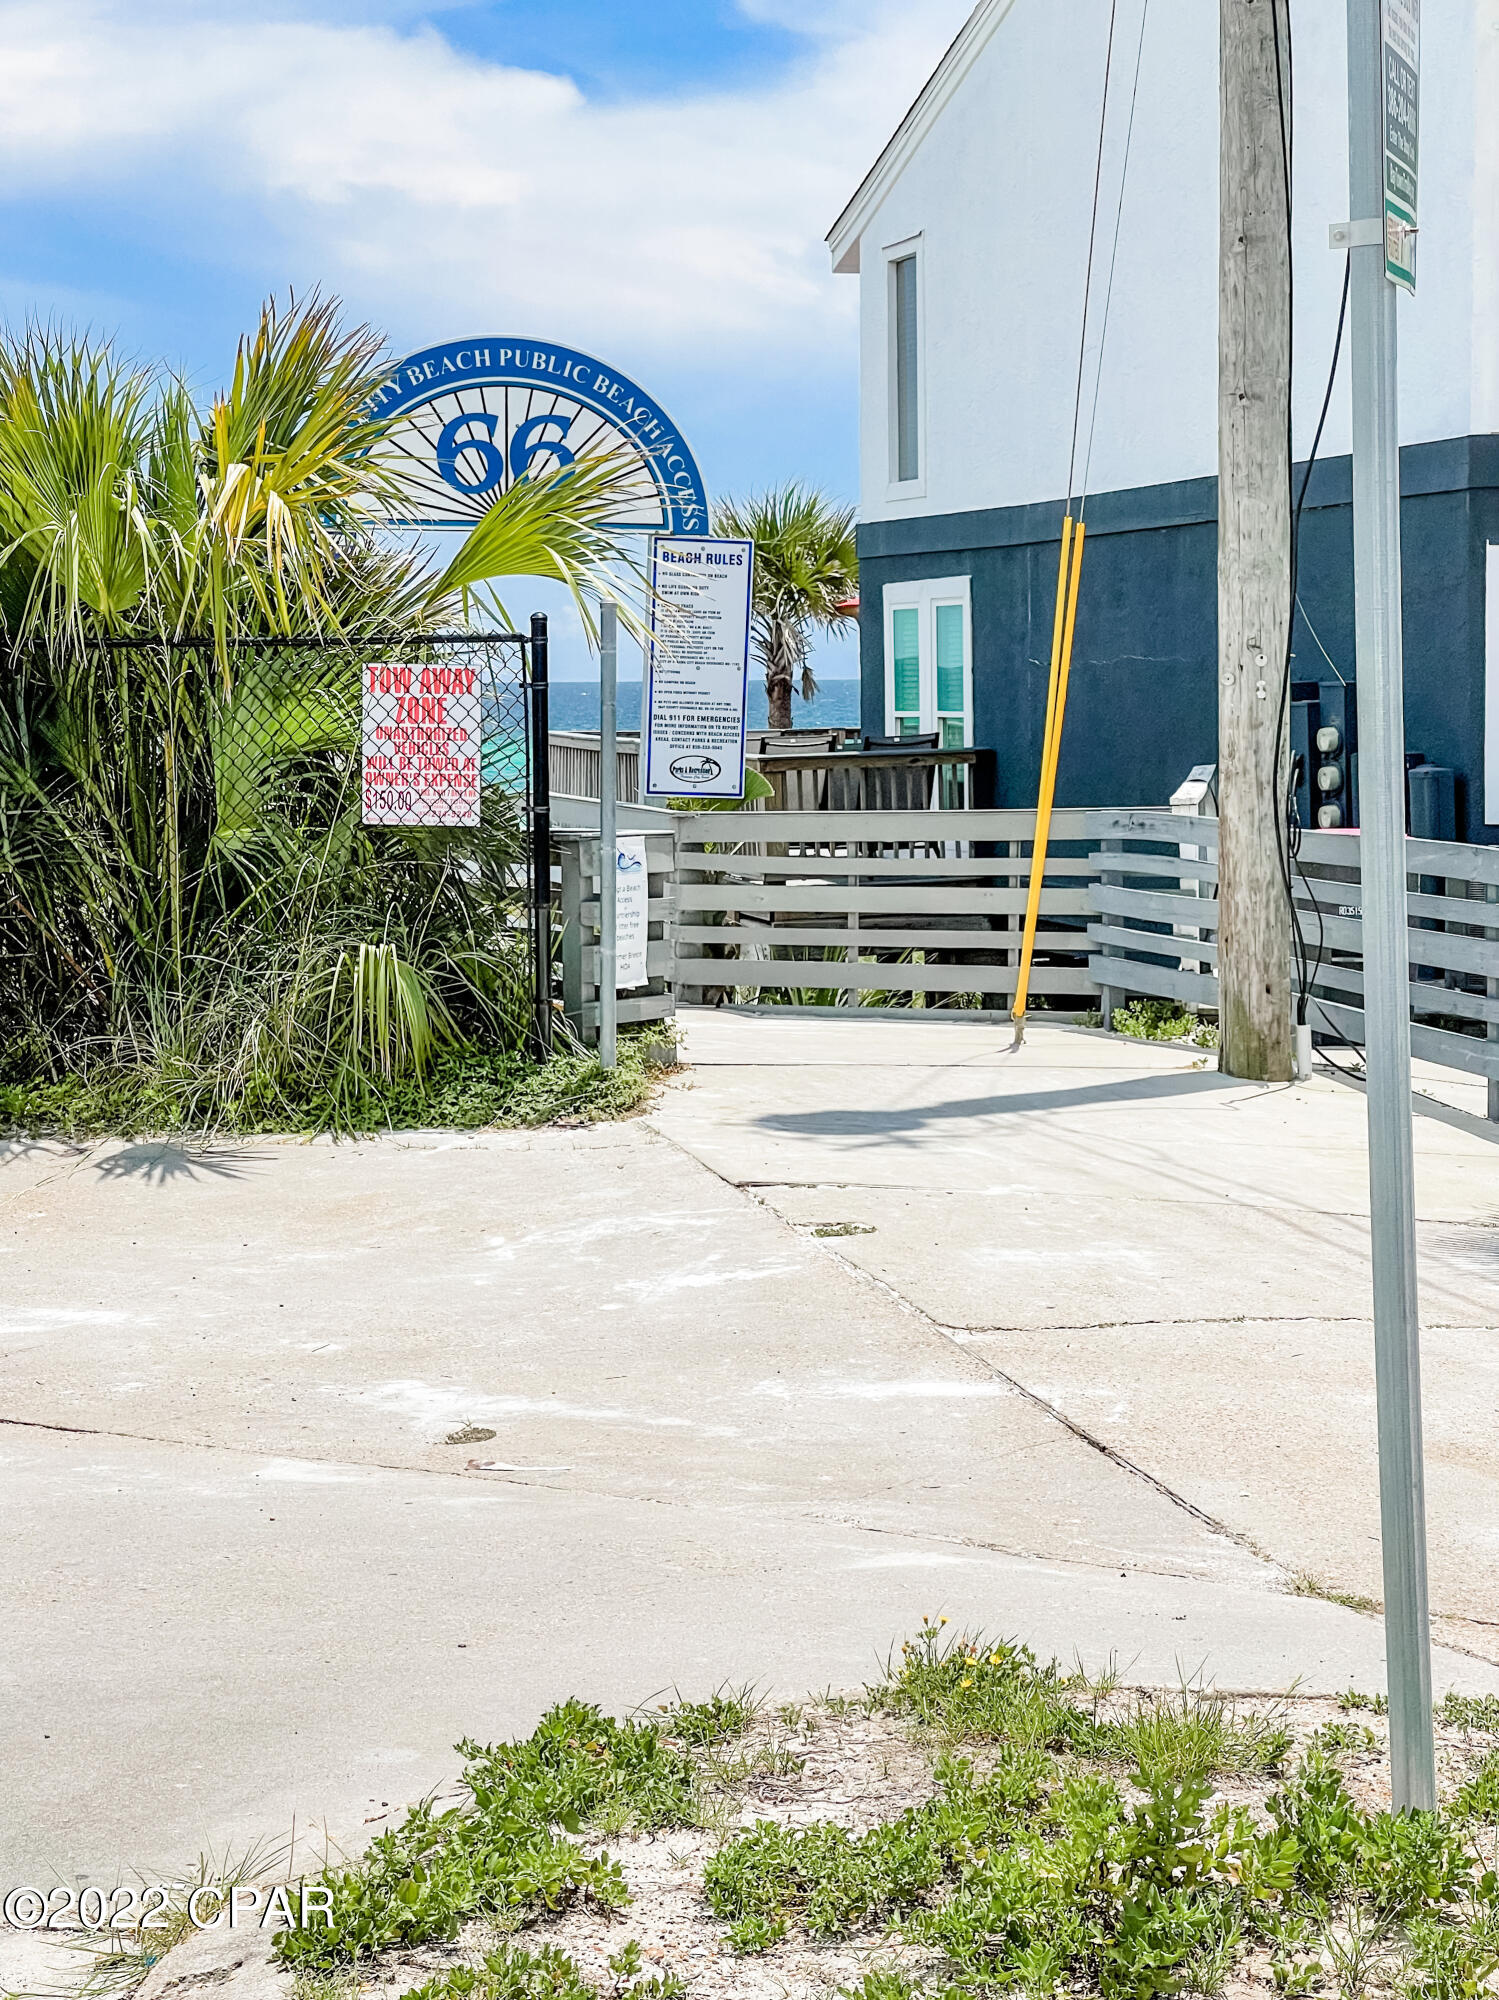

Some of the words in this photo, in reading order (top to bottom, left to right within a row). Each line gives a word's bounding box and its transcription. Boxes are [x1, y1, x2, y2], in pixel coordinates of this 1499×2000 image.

[406, 348, 491, 386] BEACH
[499, 348, 591, 384] PUBLIC
[592, 373, 665, 440] BEACH
[656, 441, 699, 531] ACCESS
[436, 412, 575, 494] 66
[662, 551, 701, 564] BEACH
[706, 553, 743, 566] RULES
[368, 666, 412, 694] TOW
[419, 667, 476, 695] AWAY
[395, 696, 447, 725] ZONE
[697, 715, 740, 723] EMERGENCIES
[375, 725, 467, 742] UNAUTHORIZED
[394, 740, 450, 756] VEHICLES
[366, 755, 395, 770] WILL
[399, 756, 413, 771] BE
[417, 756, 459, 772] TOWED
[463, 757, 476, 772] AT
[365, 771, 420, 787] OWNER'S
[424, 772, 478, 788] EXPENSE
[365, 788, 412, 811] $150.00
